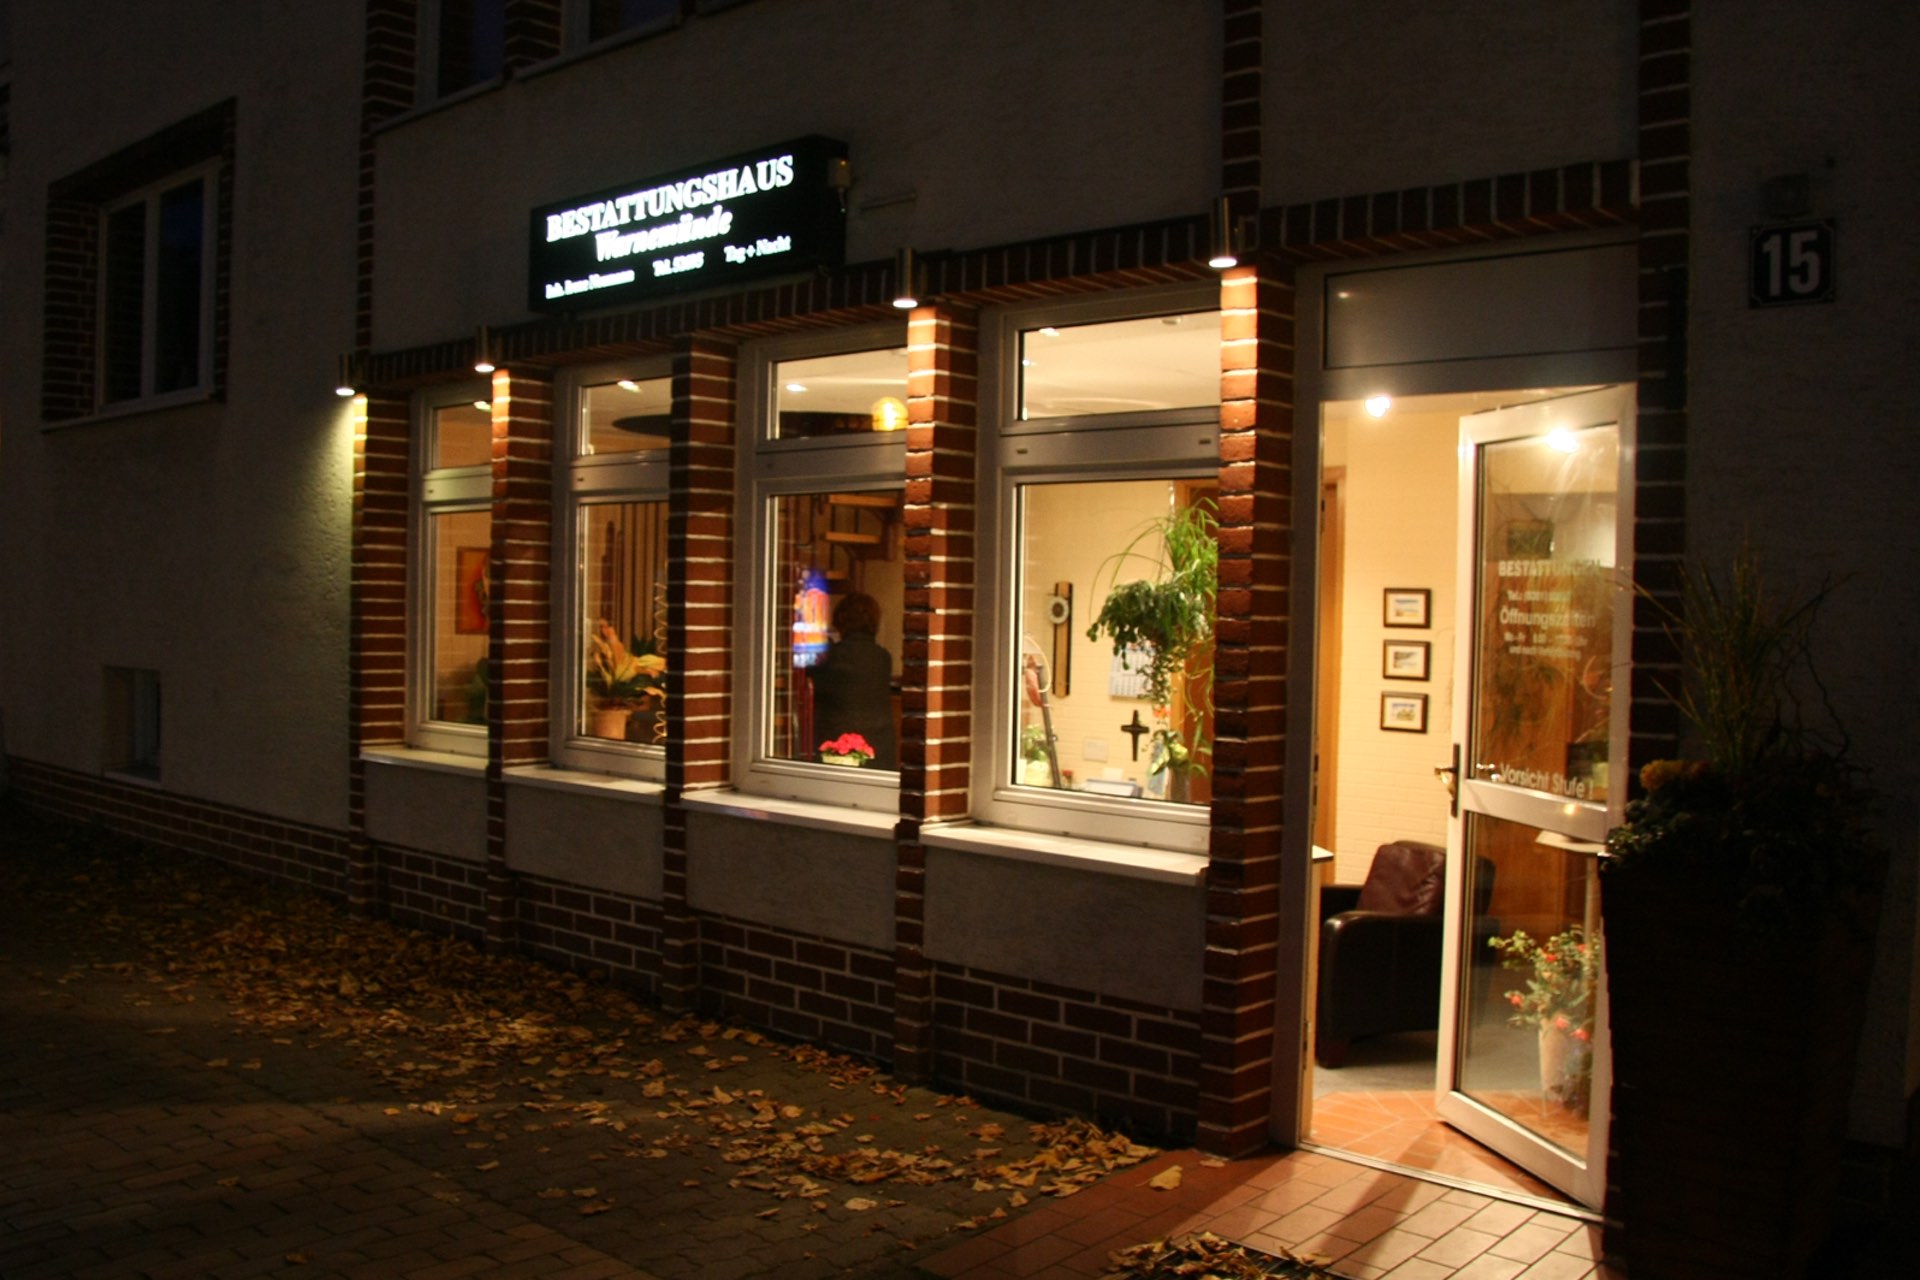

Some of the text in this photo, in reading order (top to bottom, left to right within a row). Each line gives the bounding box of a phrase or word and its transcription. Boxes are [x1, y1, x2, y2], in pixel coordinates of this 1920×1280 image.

[546, 154, 794, 242] BESTATTUNGSHAUS
[1761, 230, 1822, 297] 15
[1498, 762, 1550, 790] Vorsicht
[1551, 772, 1586, 798] Stufe
